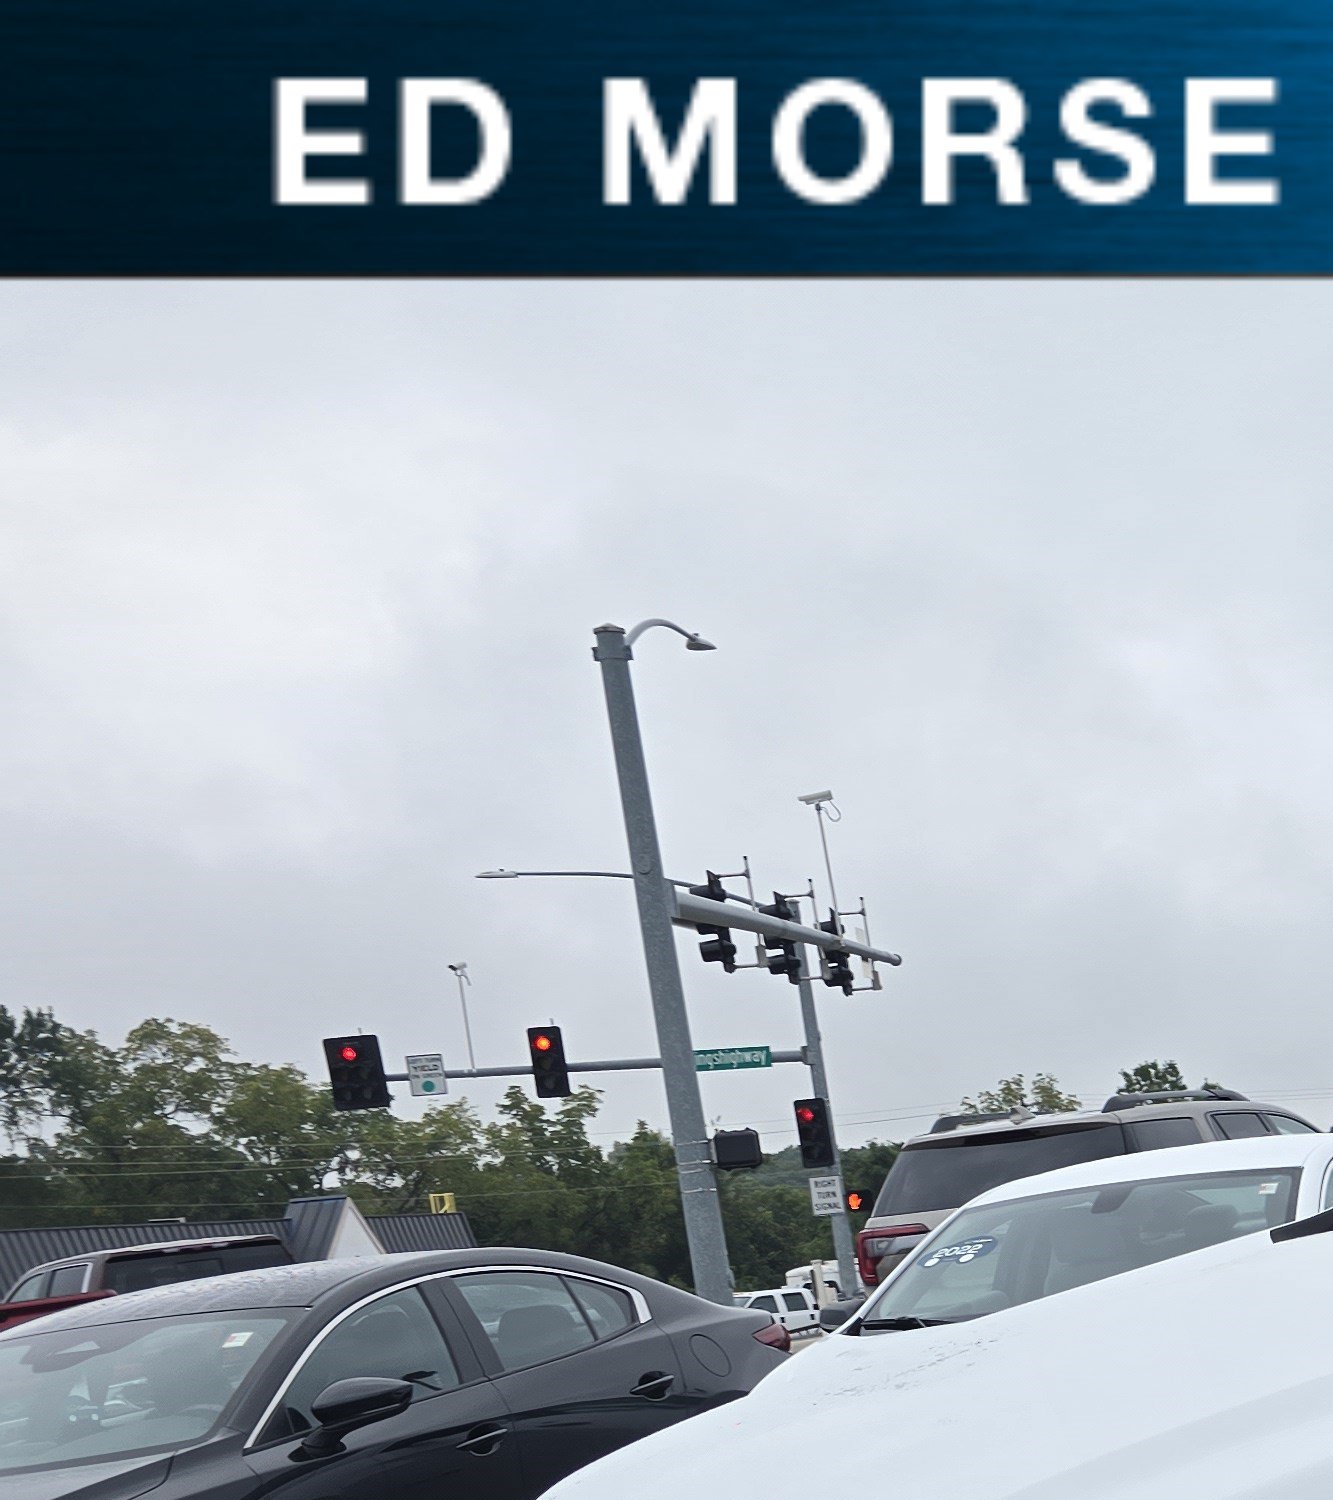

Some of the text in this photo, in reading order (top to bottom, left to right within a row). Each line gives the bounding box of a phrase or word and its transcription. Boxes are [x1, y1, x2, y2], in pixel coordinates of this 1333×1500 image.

[694, 1049, 767, 1070] ingshighway
[411, 1063, 440, 1072] YIELD
[814, 1179, 837, 1189] RIGHT
[817, 1190, 838, 1200] TURN
[815, 1202, 842, 1212] SIGNAL
[932, 1243, 984, 1259] 2022
